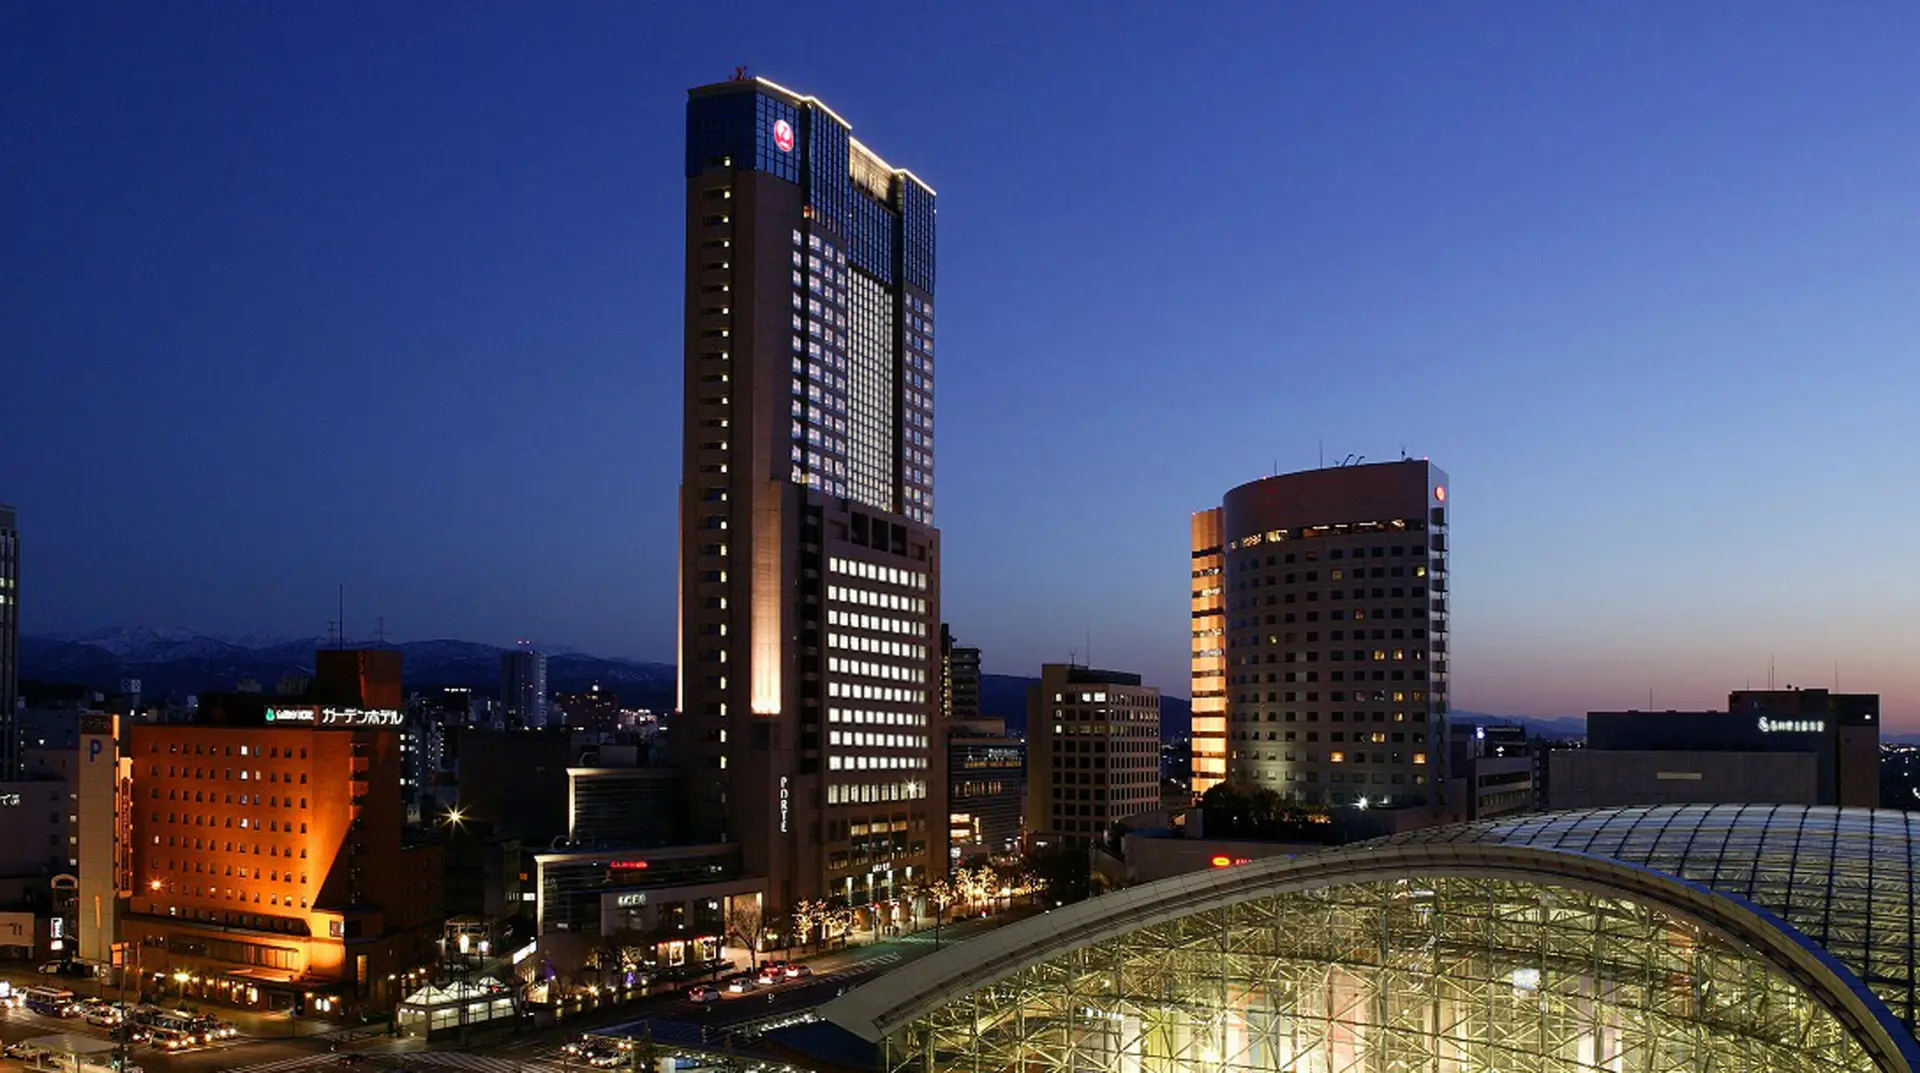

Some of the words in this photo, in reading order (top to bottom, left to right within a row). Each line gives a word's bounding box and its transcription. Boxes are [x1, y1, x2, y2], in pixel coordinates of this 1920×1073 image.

[321, 707, 404, 725] ガーデンホテル
[90, 739, 102, 762] P
